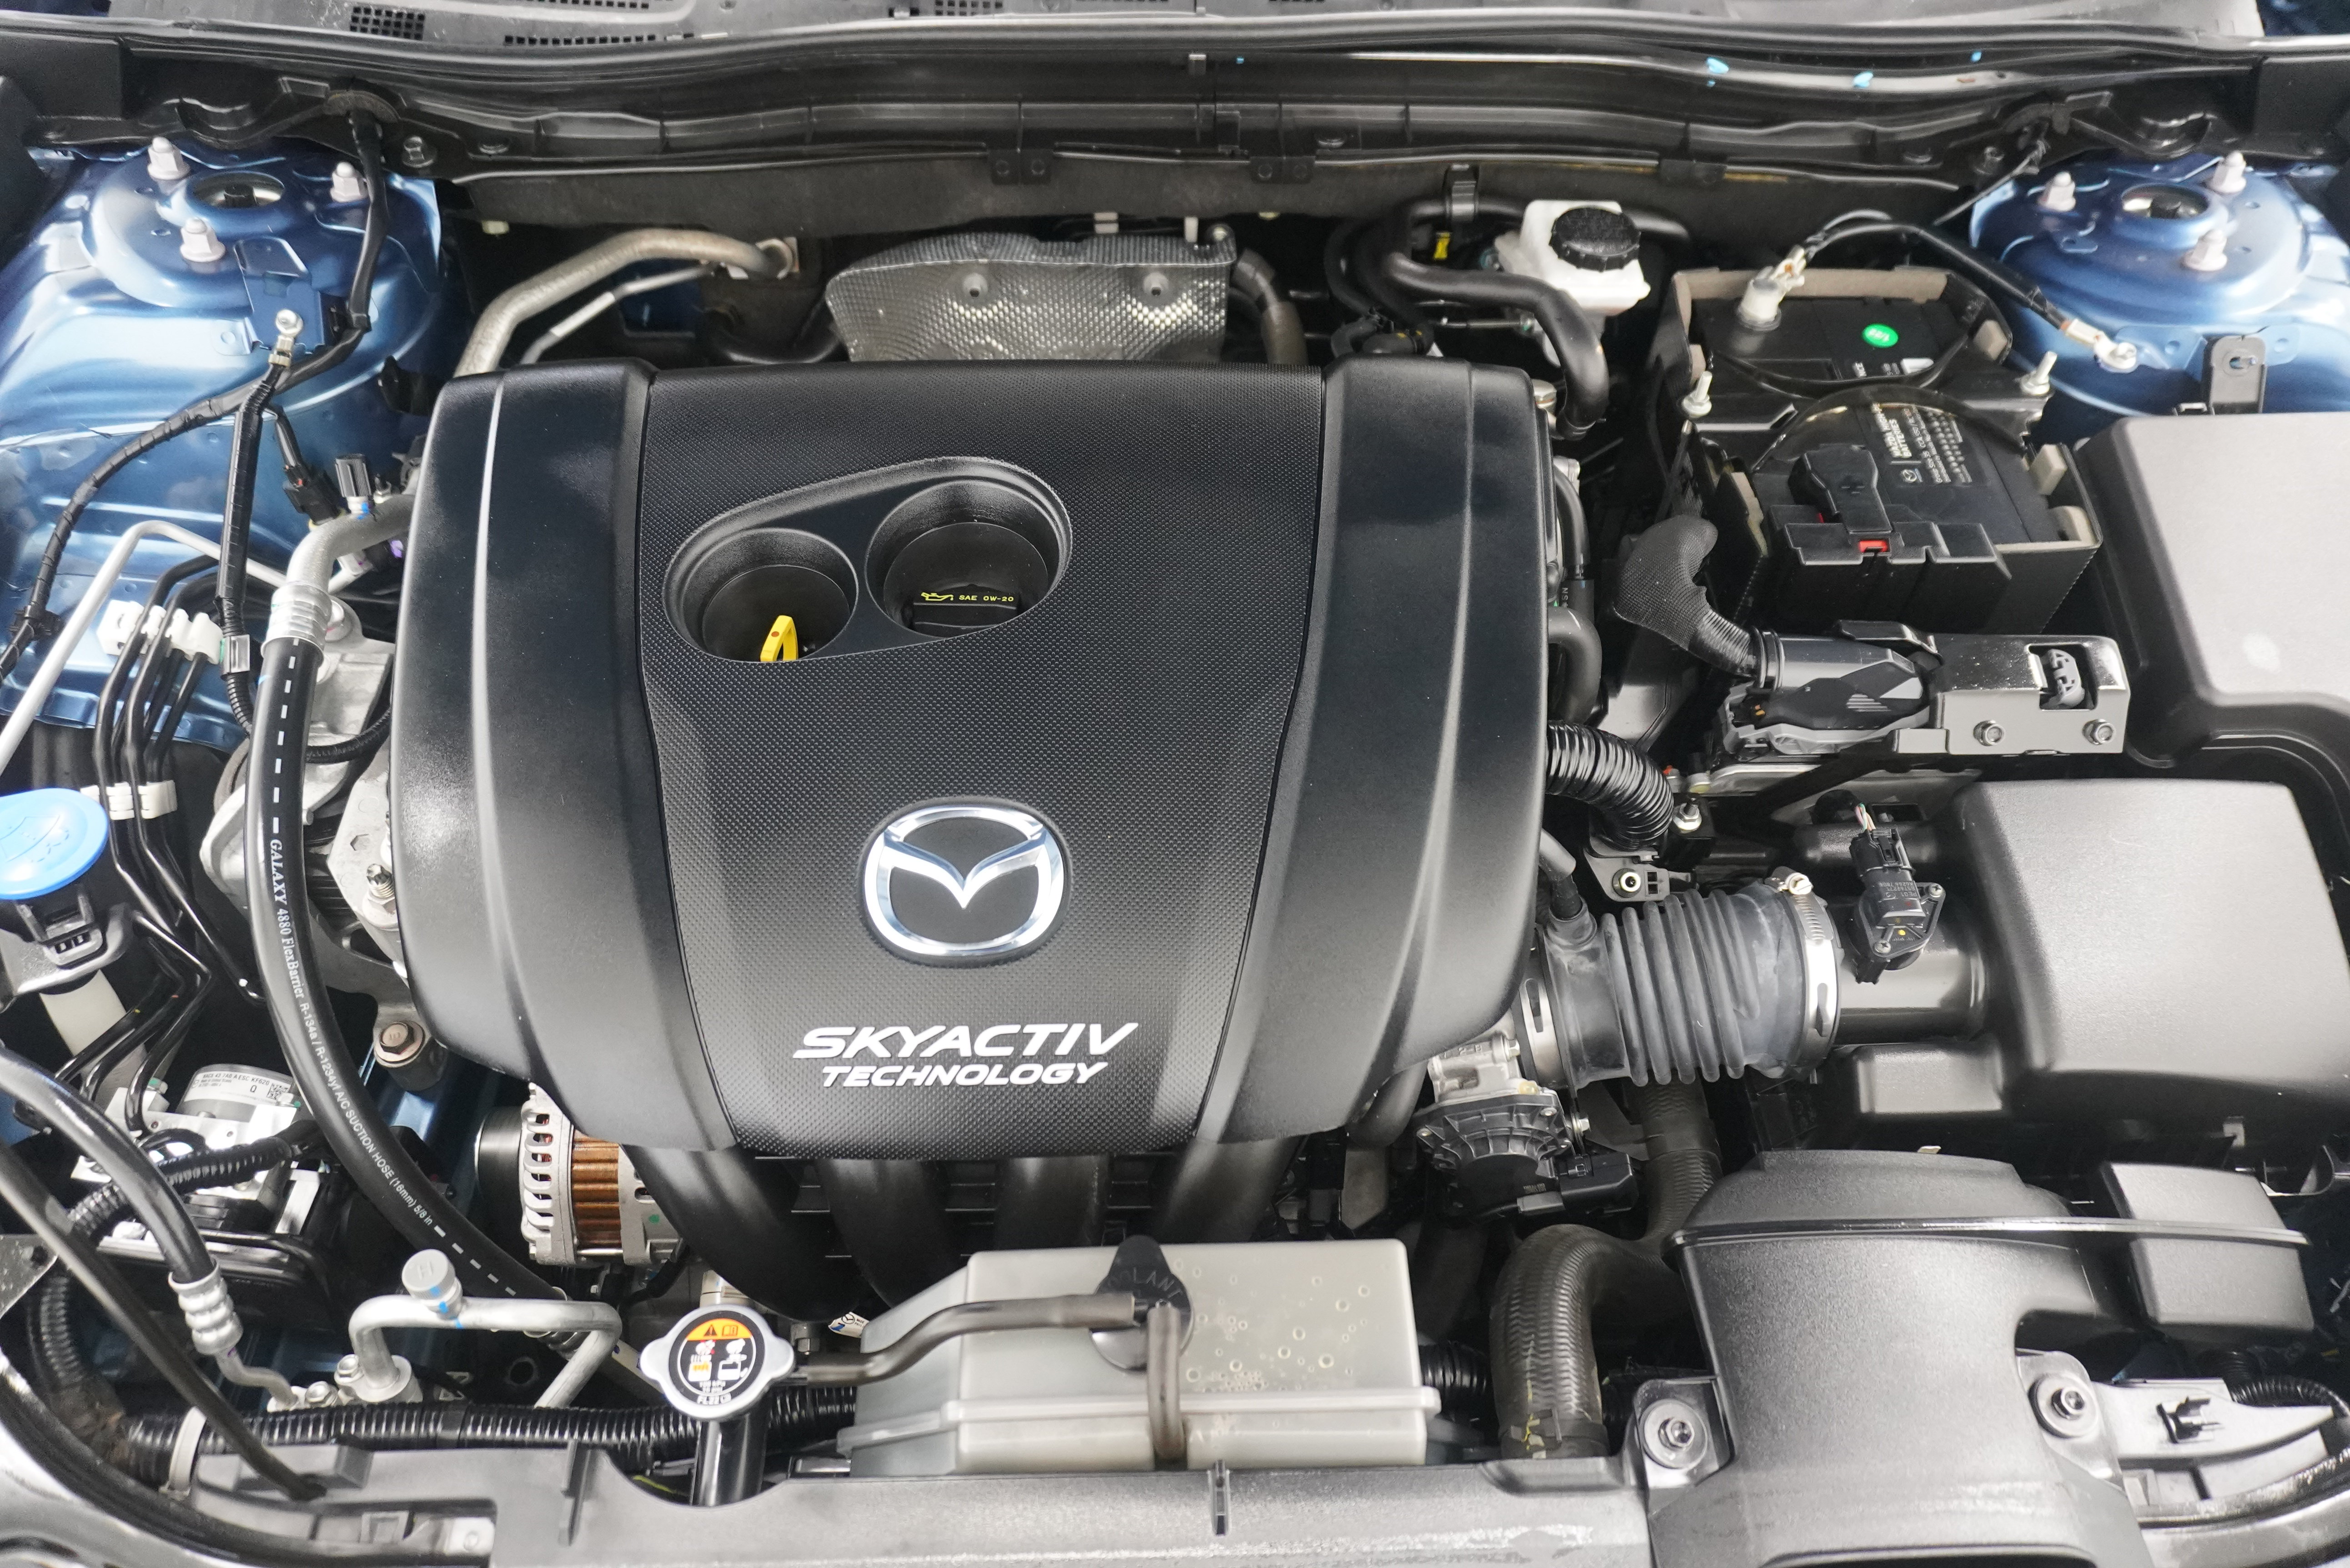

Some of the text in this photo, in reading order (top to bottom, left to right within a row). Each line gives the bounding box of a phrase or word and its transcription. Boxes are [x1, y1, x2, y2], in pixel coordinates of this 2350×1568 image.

[1885, 432, 1903, 457] MAZDA
[1889, 419, 1912, 458] BATTERIES
[270, 839, 287, 905] GALAXY
[277, 908, 291, 935] 4880
[281, 937, 305, 999] FlexBarrier
[300, 1002, 317, 1040] R-134a
[793, 1022, 1139, 1059] SKYACTIV
[822, 1062, 1109, 1087] TECHNOLOGY
[335, 1091, 350, 1110] A/C
[346, 1110, 376, 1153] SUCTION
[372, 1152, 395, 1179] HOSE
[389, 1177, 417, 1207] (16mm)
[414, 1205, 427, 1219] 5/8
[424, 1215, 432, 1226] in
[417, 1260, 433, 1280] H
